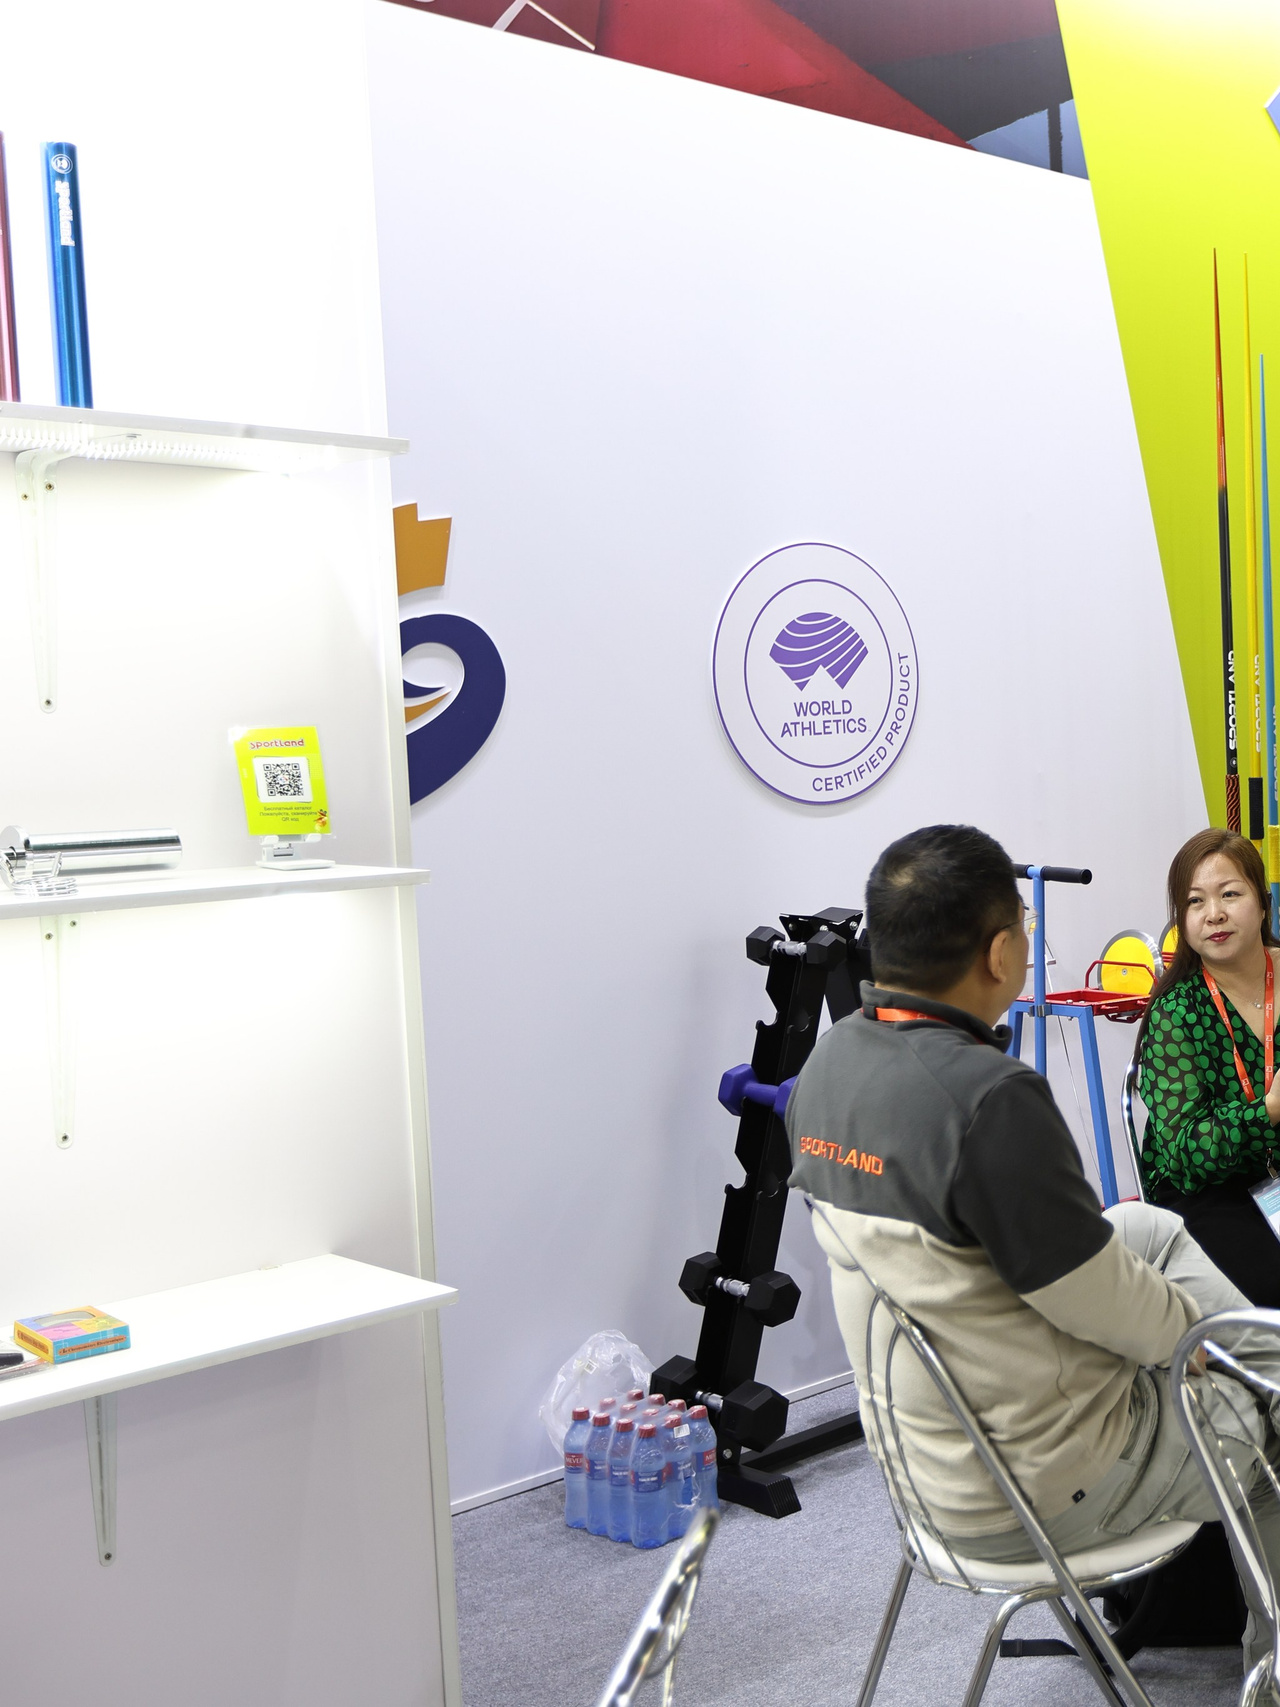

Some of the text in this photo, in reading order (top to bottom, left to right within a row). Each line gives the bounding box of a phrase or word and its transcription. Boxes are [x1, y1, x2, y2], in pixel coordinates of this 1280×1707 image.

[793, 699, 853, 717] WORLD
[812, 652, 911, 792] CERTIFIED PRODUCT
[781, 717, 867, 738] ATHLETICS
[800, 1136, 884, 1176] SPORTLAND
